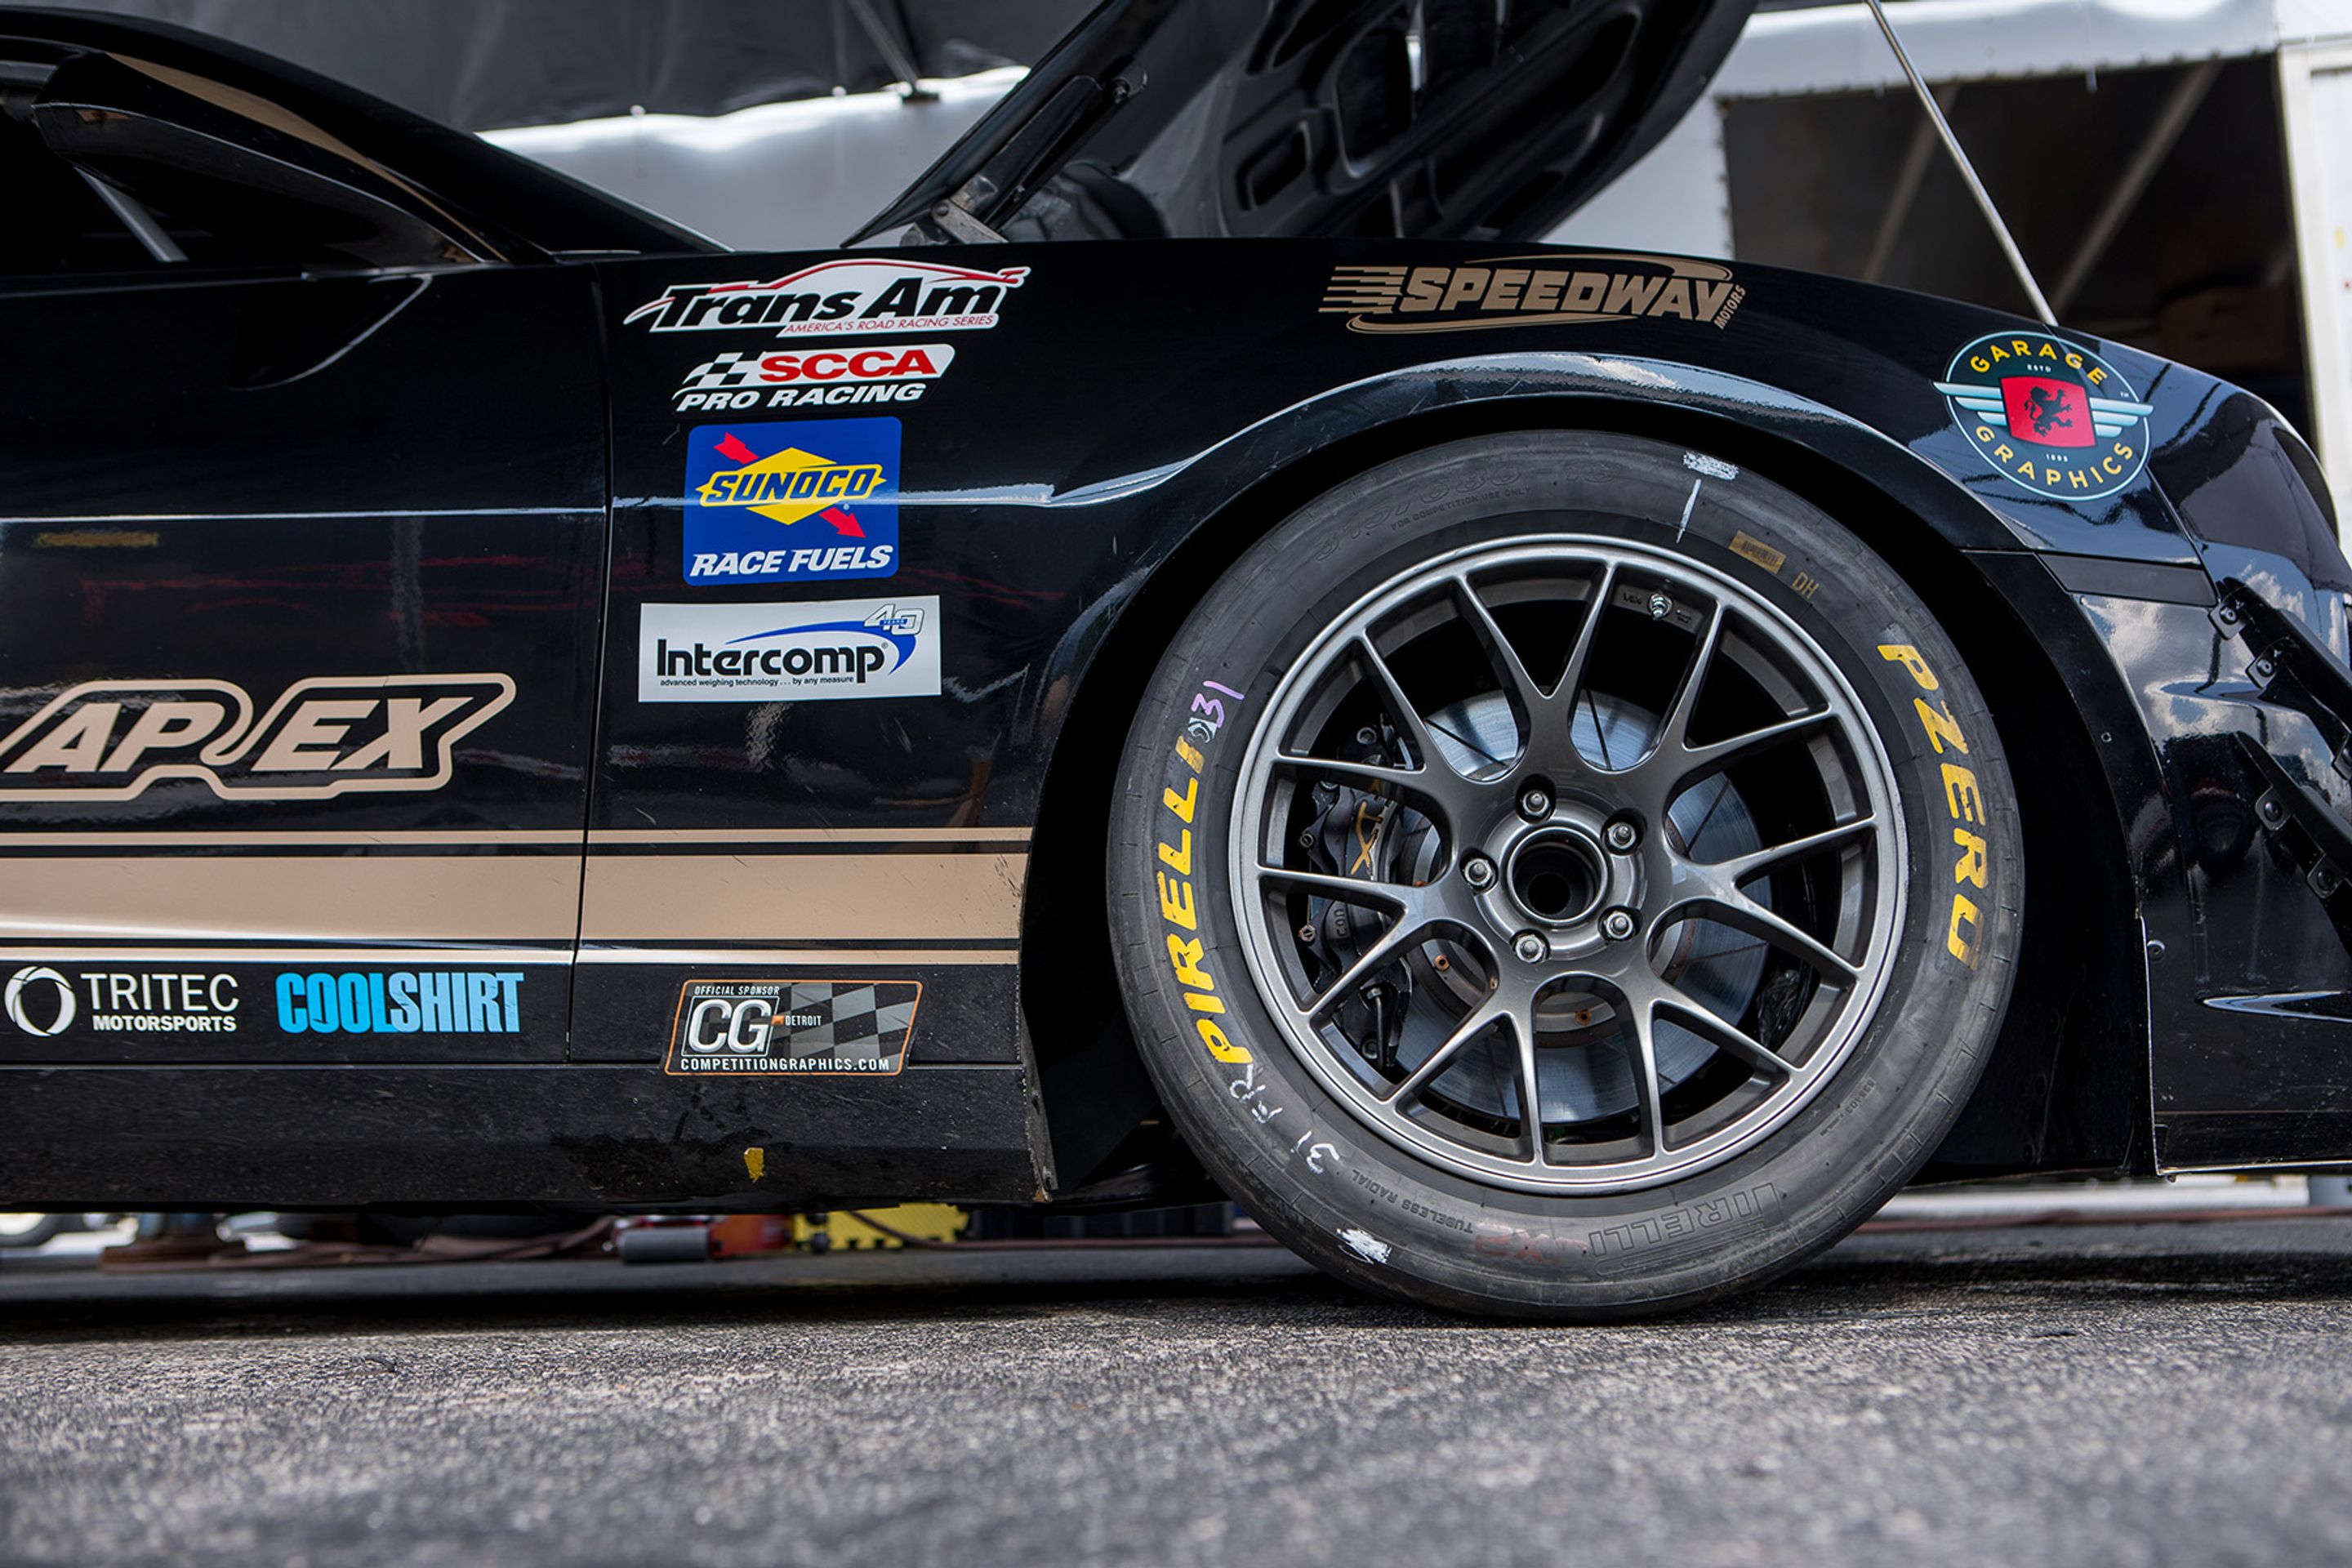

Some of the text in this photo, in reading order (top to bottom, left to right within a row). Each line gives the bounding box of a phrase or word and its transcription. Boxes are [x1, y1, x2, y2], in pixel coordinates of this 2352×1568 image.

[657, 277, 1001, 327] Trans Am
[1399, 267, 1734, 322] SPEEDWAY
[1713, 284, 1746, 330] MOTORS
[784, 314, 994, 334] AMERICA'S ROAD RACING SERIES
[759, 350, 938, 382] SCCA
[1970, 340, 2108, 385] GARAGE
[675, 384, 926, 412] PRO RACING
[1976, 425, 2133, 488] GRAPHICS
[706, 468, 875, 504] SUNOCO
[1391, 487, 1531, 530] FOR COMPETITION USE ONLY
[689, 545, 893, 577] RACE FUELS
[1791, 572, 1820, 599] DH
[863, 604, 925, 635] 40
[657, 639, 885, 683] Intercomp
[660, 679, 697, 687] advanced
[698, 678, 733, 688] weighing
[735, 677, 778, 687] technology
[792, 677, 802, 686] by
[819, 676, 853, 684] measure
[2, 697, 475, 773] APEX
[1156, 735, 1254, 1064] PIRELLI
[81, 973, 239, 1013] TRITEC
[275, 972, 524, 1033] COOLSHIRT
[694, 986, 780, 996] OFFICIAL SPONSOR
[92, 1014, 237, 1032] MOTORSPORTS
[688, 999, 772, 1054] CG
[785, 1015, 822, 1027] DETROIT
[680, 1058, 889, 1071] COMPETITIONGRAPHICS.COM
[1352, 1169, 1474, 1234] TUBELESS RADIAL
